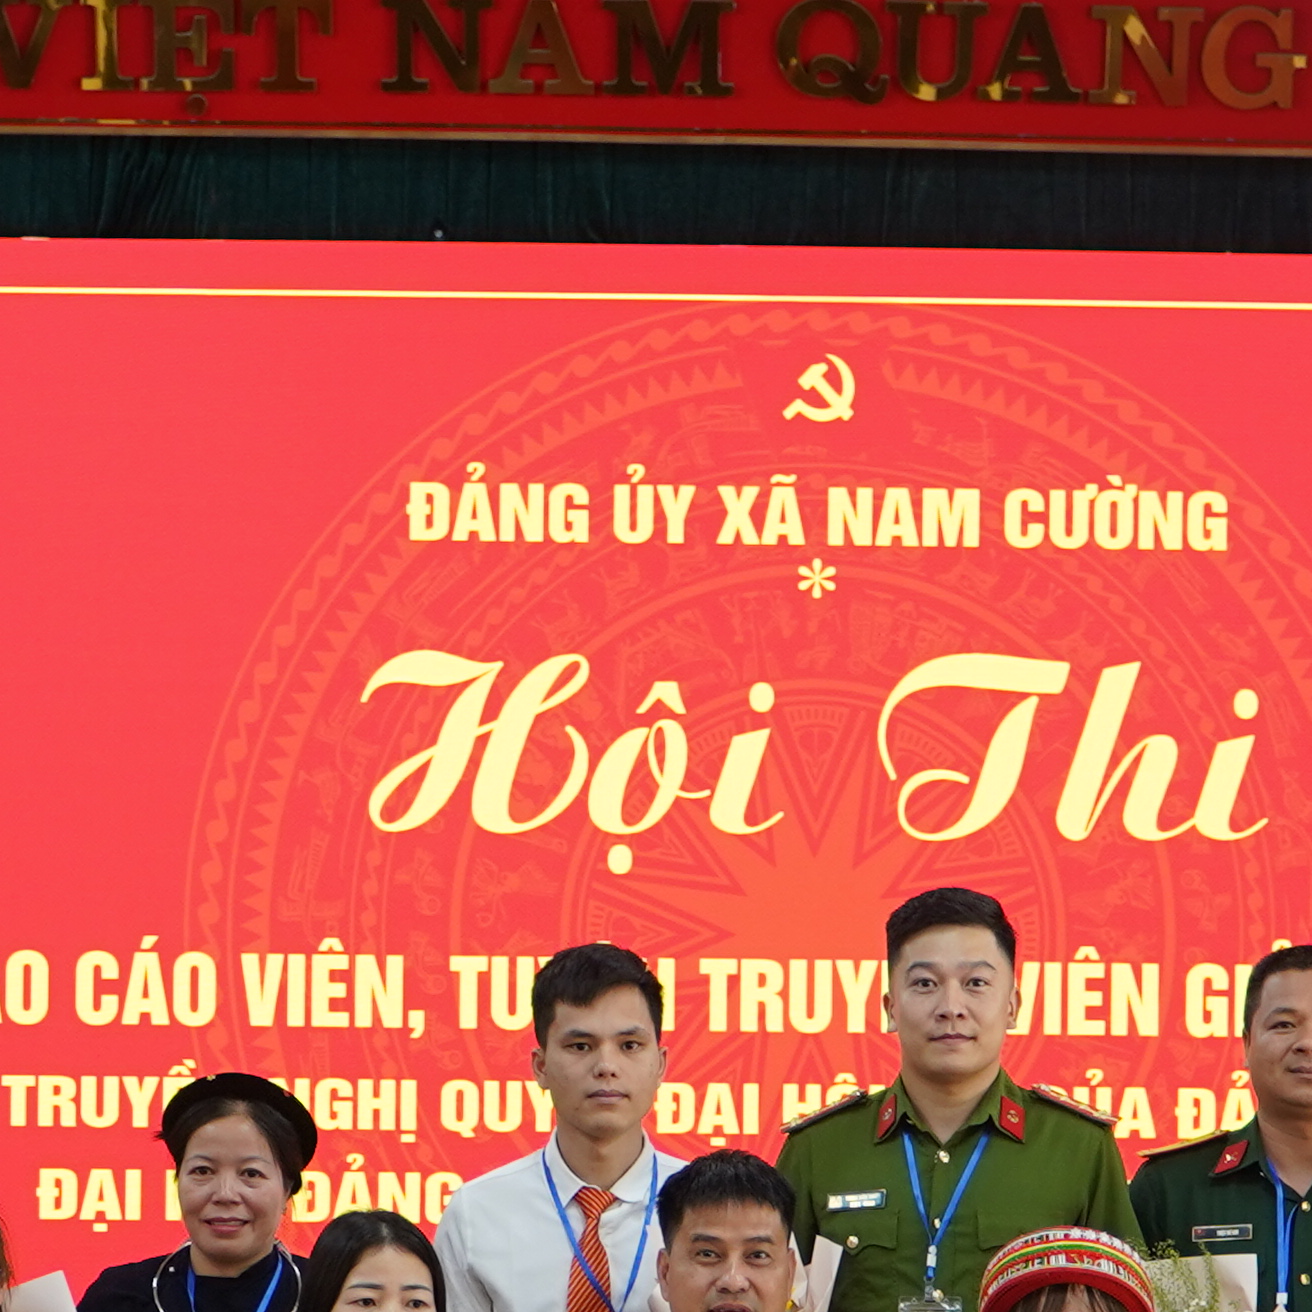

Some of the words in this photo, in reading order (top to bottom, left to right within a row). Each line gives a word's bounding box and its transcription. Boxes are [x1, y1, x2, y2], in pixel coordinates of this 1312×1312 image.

[381, 0, 734, 97] NAM
[777, 0, 1307, 110] QUANG
[406, 462, 590, 543] ĐẢNG
[613, 464, 696, 545] ỦY
[716, 474, 805, 545] XÃ
[826, 487, 980, 548] NAM
[1004, 474, 1229, 551] CƯỜNG
[360, 649, 785, 874] Hội
[877, 652, 1269, 842] Thi
[75, 935, 218, 1027] CÁO
[241, 937, 425, 1039] VIÊN,
[699, 958, 891, 1034] TRUY
[441, 1079, 554, 1134] QUY
[653, 1079, 760, 1147] ĐẠI
[36, 1168, 142, 1232] ĐẠI
